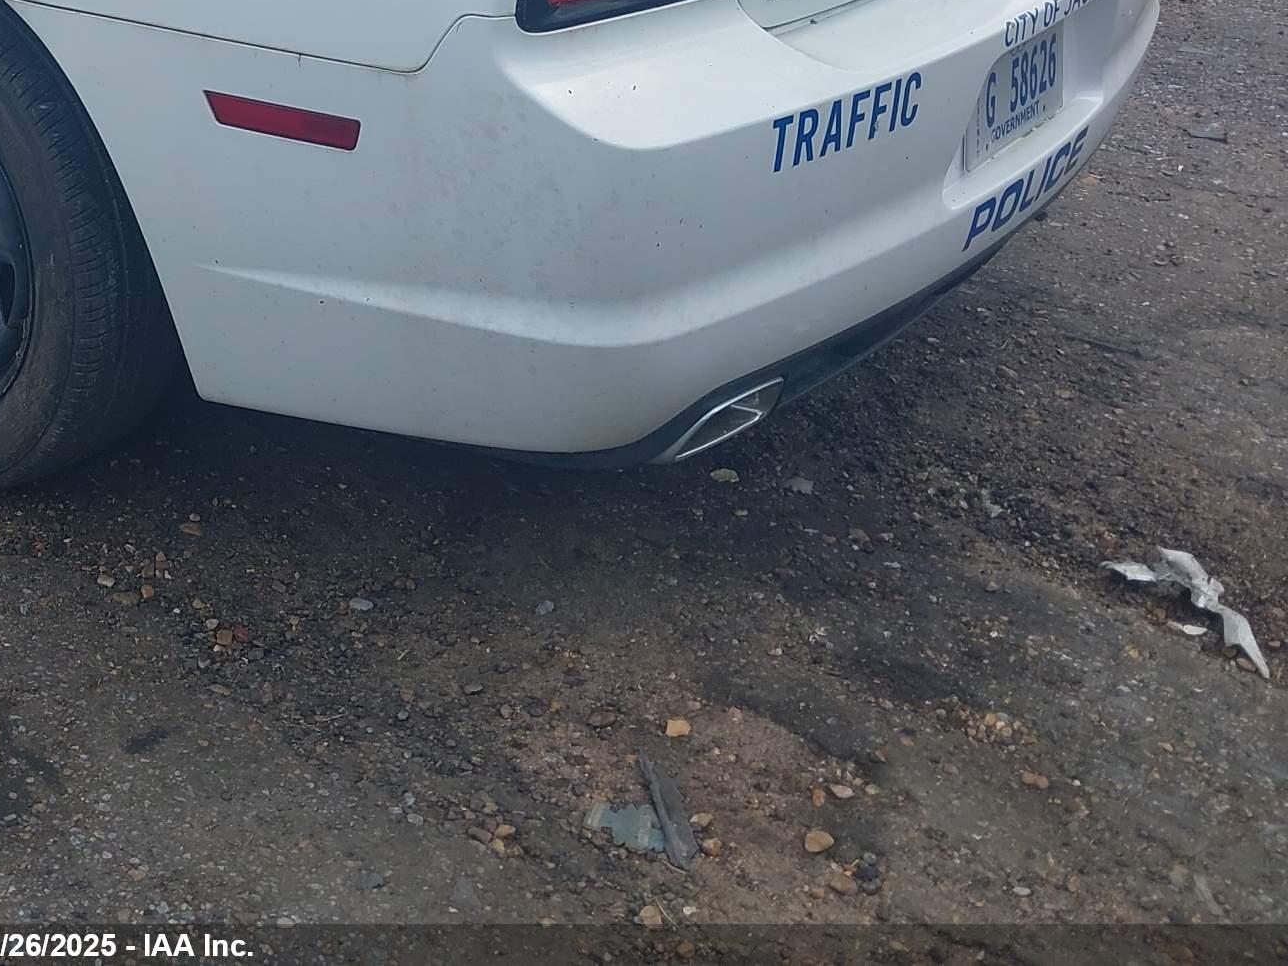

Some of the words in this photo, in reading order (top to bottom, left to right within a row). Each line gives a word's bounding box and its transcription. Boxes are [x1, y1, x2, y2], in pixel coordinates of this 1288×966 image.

[1004, 8, 1039, 48] CITY
[772, 71, 922, 173] TRAFFIC
[985, 71, 998, 129] G
[1009, 32, 1058, 113] 58626
[991, 100, 1041, 144] GOVERNMENT
[962, 125, 1090, 252] POLICE
